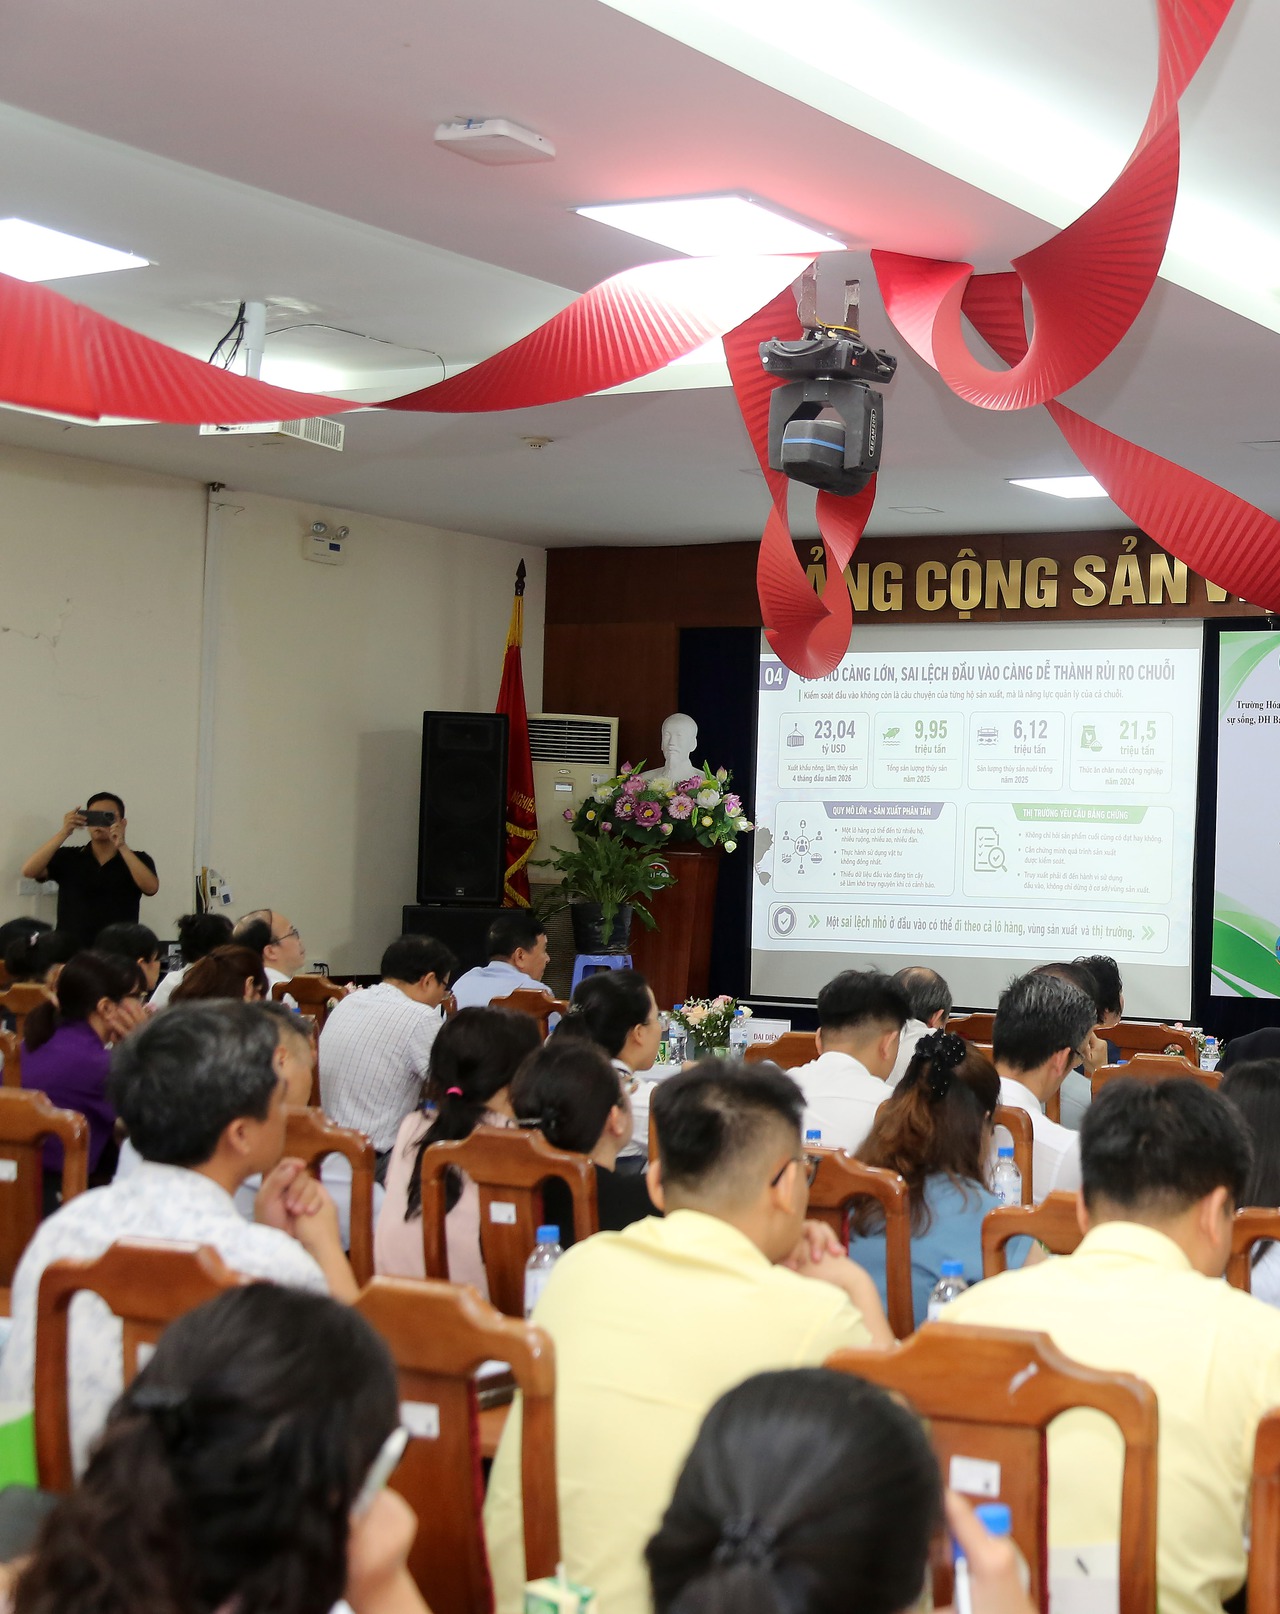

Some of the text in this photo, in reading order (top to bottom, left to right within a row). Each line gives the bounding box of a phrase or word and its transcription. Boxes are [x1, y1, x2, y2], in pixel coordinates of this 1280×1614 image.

[916, 549, 1056, 619] CỘNG
[1073, 536, 1190, 606] SẢN
[764, 667, 783, 685] 04
[1236, 700, 1264, 711] Trường
[1266, 700, 1280, 709] Hóa
[1226, 717, 1236, 726] sự
[1237, 714, 1256, 725] sống,
[1258, 715, 1270, 724] ĐH
[813, 720, 856, 742] 23,04
[913, 719, 950, 742] 9,95
[1012, 719, 1048, 742] 6,12
[1118, 720, 1159, 743] 21,5
[822, 743, 845, 755] tỷ USD
[914, 743, 946, 755] triệu tấn
[1013, 744, 1046, 756] triệu tấn
[1119, 744, 1155, 757] triệu tấn
[753, 1033, 764, 1041] ĐẠI
